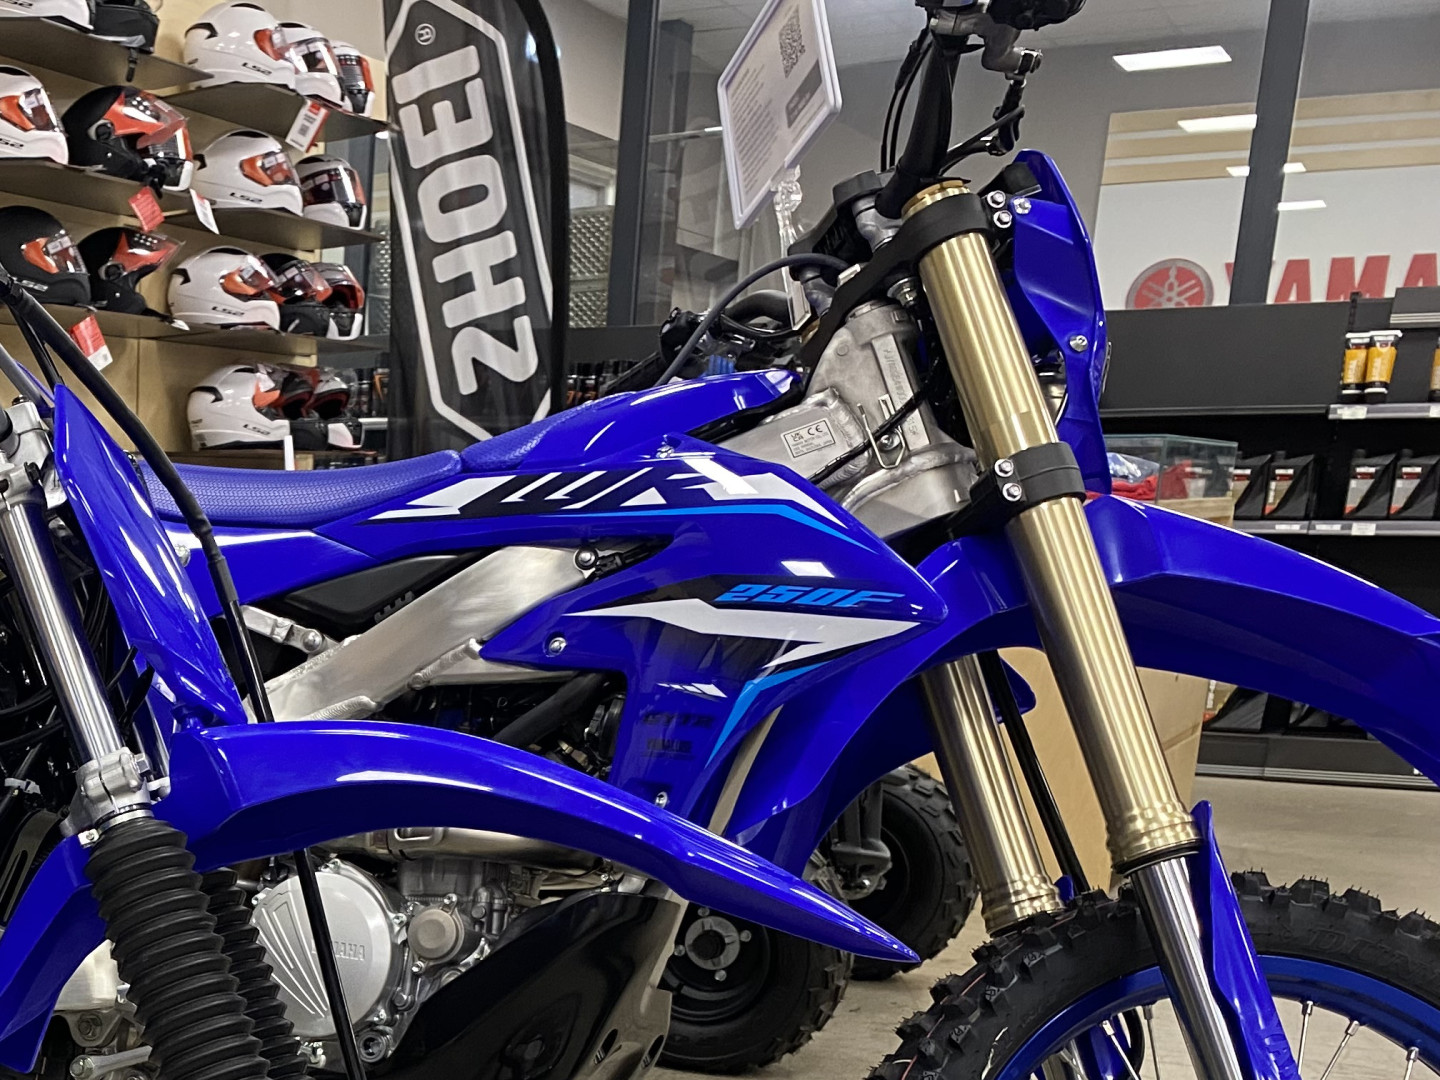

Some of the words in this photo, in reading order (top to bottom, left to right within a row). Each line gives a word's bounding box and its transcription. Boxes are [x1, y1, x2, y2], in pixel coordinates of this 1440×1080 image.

[242, 61, 272, 76] LS2
[230, 192, 263, 203] LS2
[211, 305, 246, 317] LS2
[242, 424, 270, 436] LS2
[807, 424, 823, 436] CE
[714, 583, 906, 608] 250F
